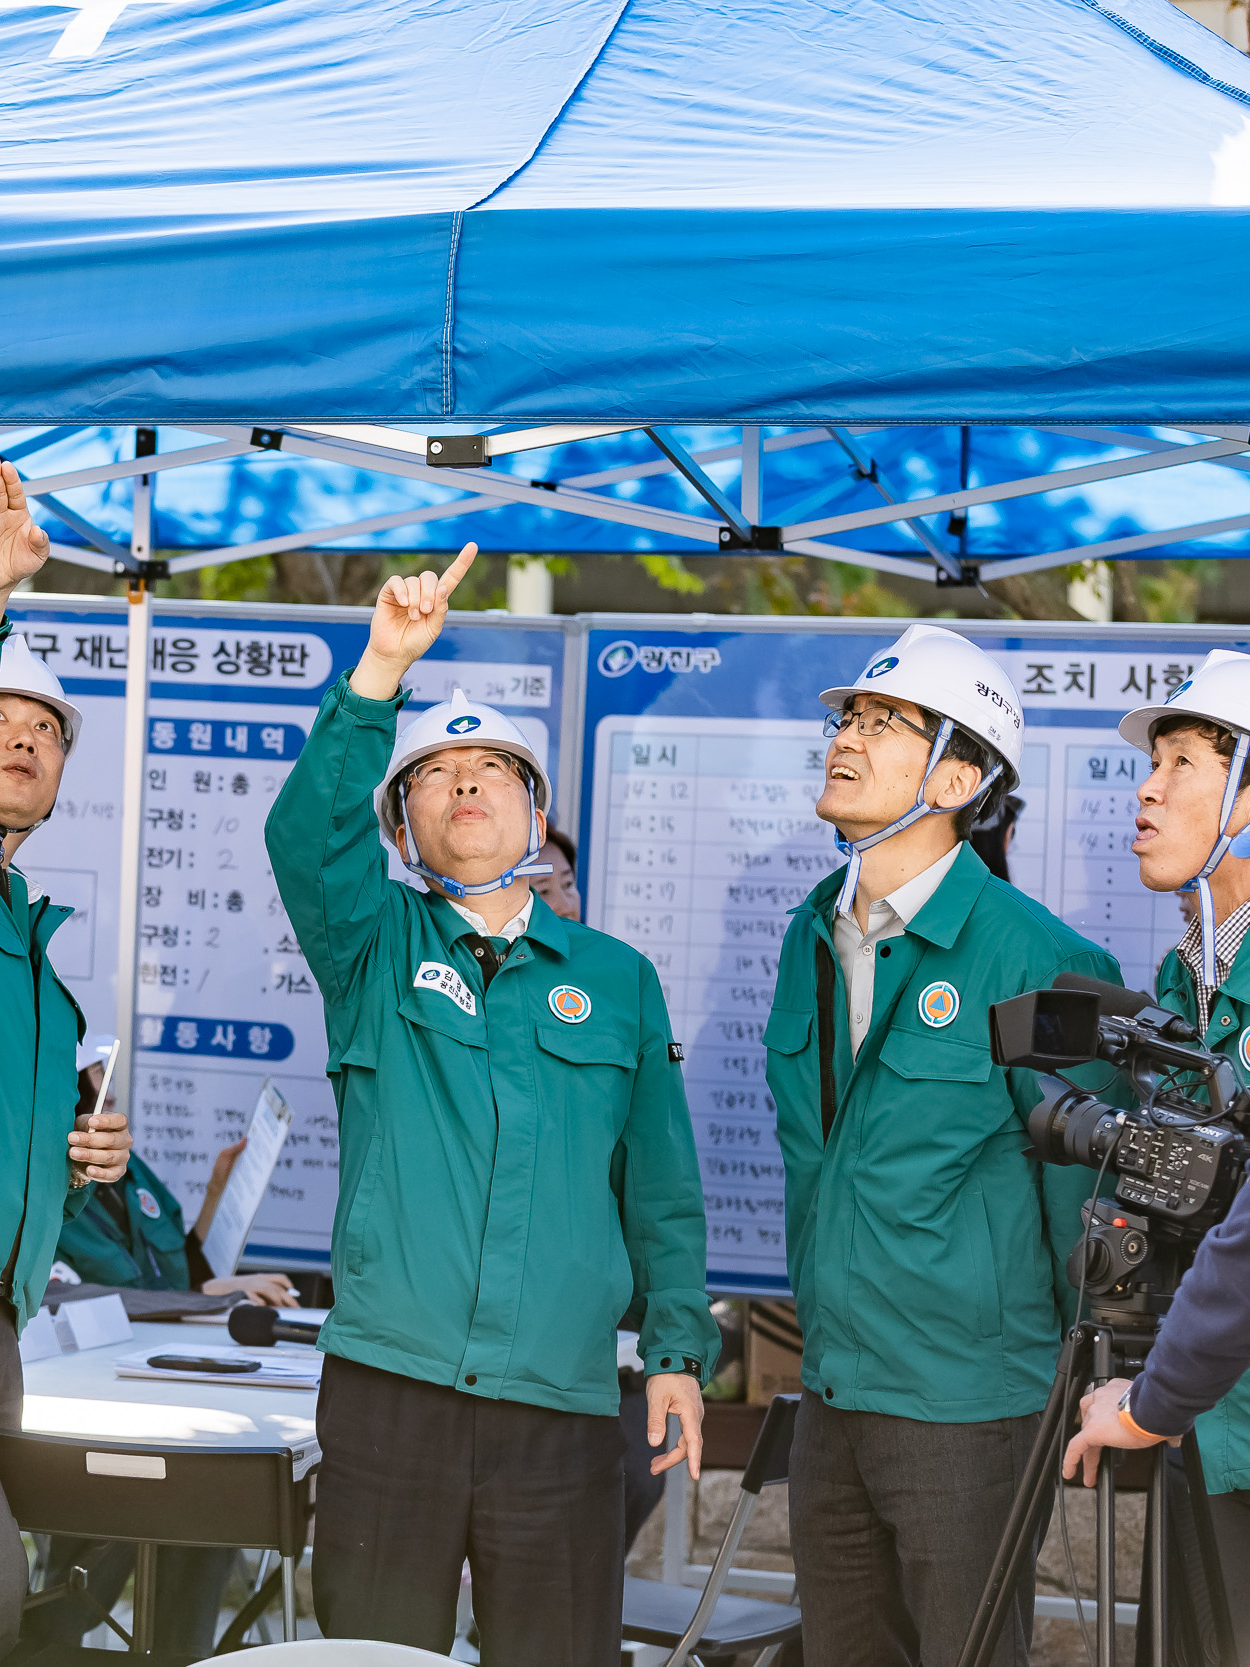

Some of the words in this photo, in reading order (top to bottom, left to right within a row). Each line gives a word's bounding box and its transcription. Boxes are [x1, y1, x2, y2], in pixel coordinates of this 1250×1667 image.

[212, 641, 311, 678] 상황판
[640, 648, 720, 672] 광진구
[511, 675, 546, 697] 기준
[1022, 663, 1096, 700] 조치
[974, 680, 1021, 729] 광진구청
[151, 721, 285, 755] 동원내역
[631, 743, 678, 766] 일시
[1088, 756, 1136, 781] 일시
[274, 973, 313, 994] 가스
[1193, 1124, 1223, 1139] SONY
